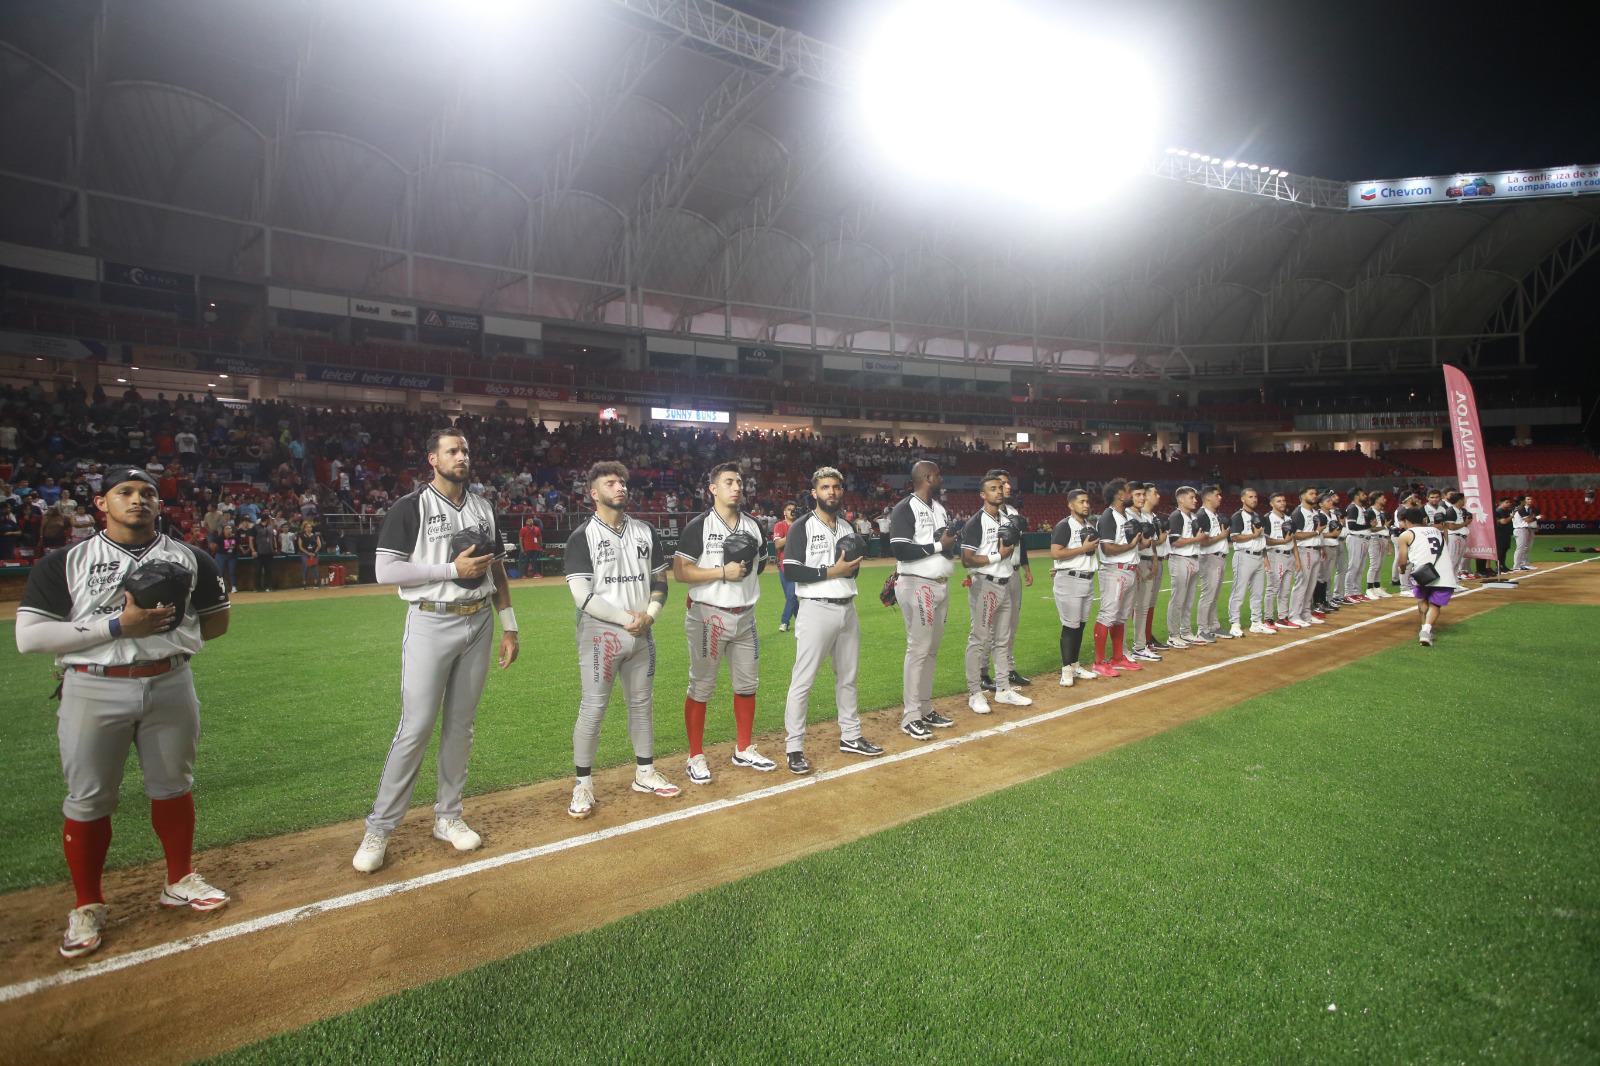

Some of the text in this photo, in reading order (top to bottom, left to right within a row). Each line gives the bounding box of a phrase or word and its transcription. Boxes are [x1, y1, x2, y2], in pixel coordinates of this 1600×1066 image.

[1507, 175, 1519, 184] La
[1573, 170, 1586, 179] de
[1380, 186, 1432, 198] Chevron
[1507, 180, 1568, 192] acompañado
[1570, 180, 1582, 188] en
[321, 367, 430, 388] telcel telcel telcel
[512, 386, 535, 396] 97.9
[666, 409, 692, 419] SUNNY
[708, 533, 724, 541] ms
[811, 534, 826, 543] ms
[89, 560, 121, 575] ms
